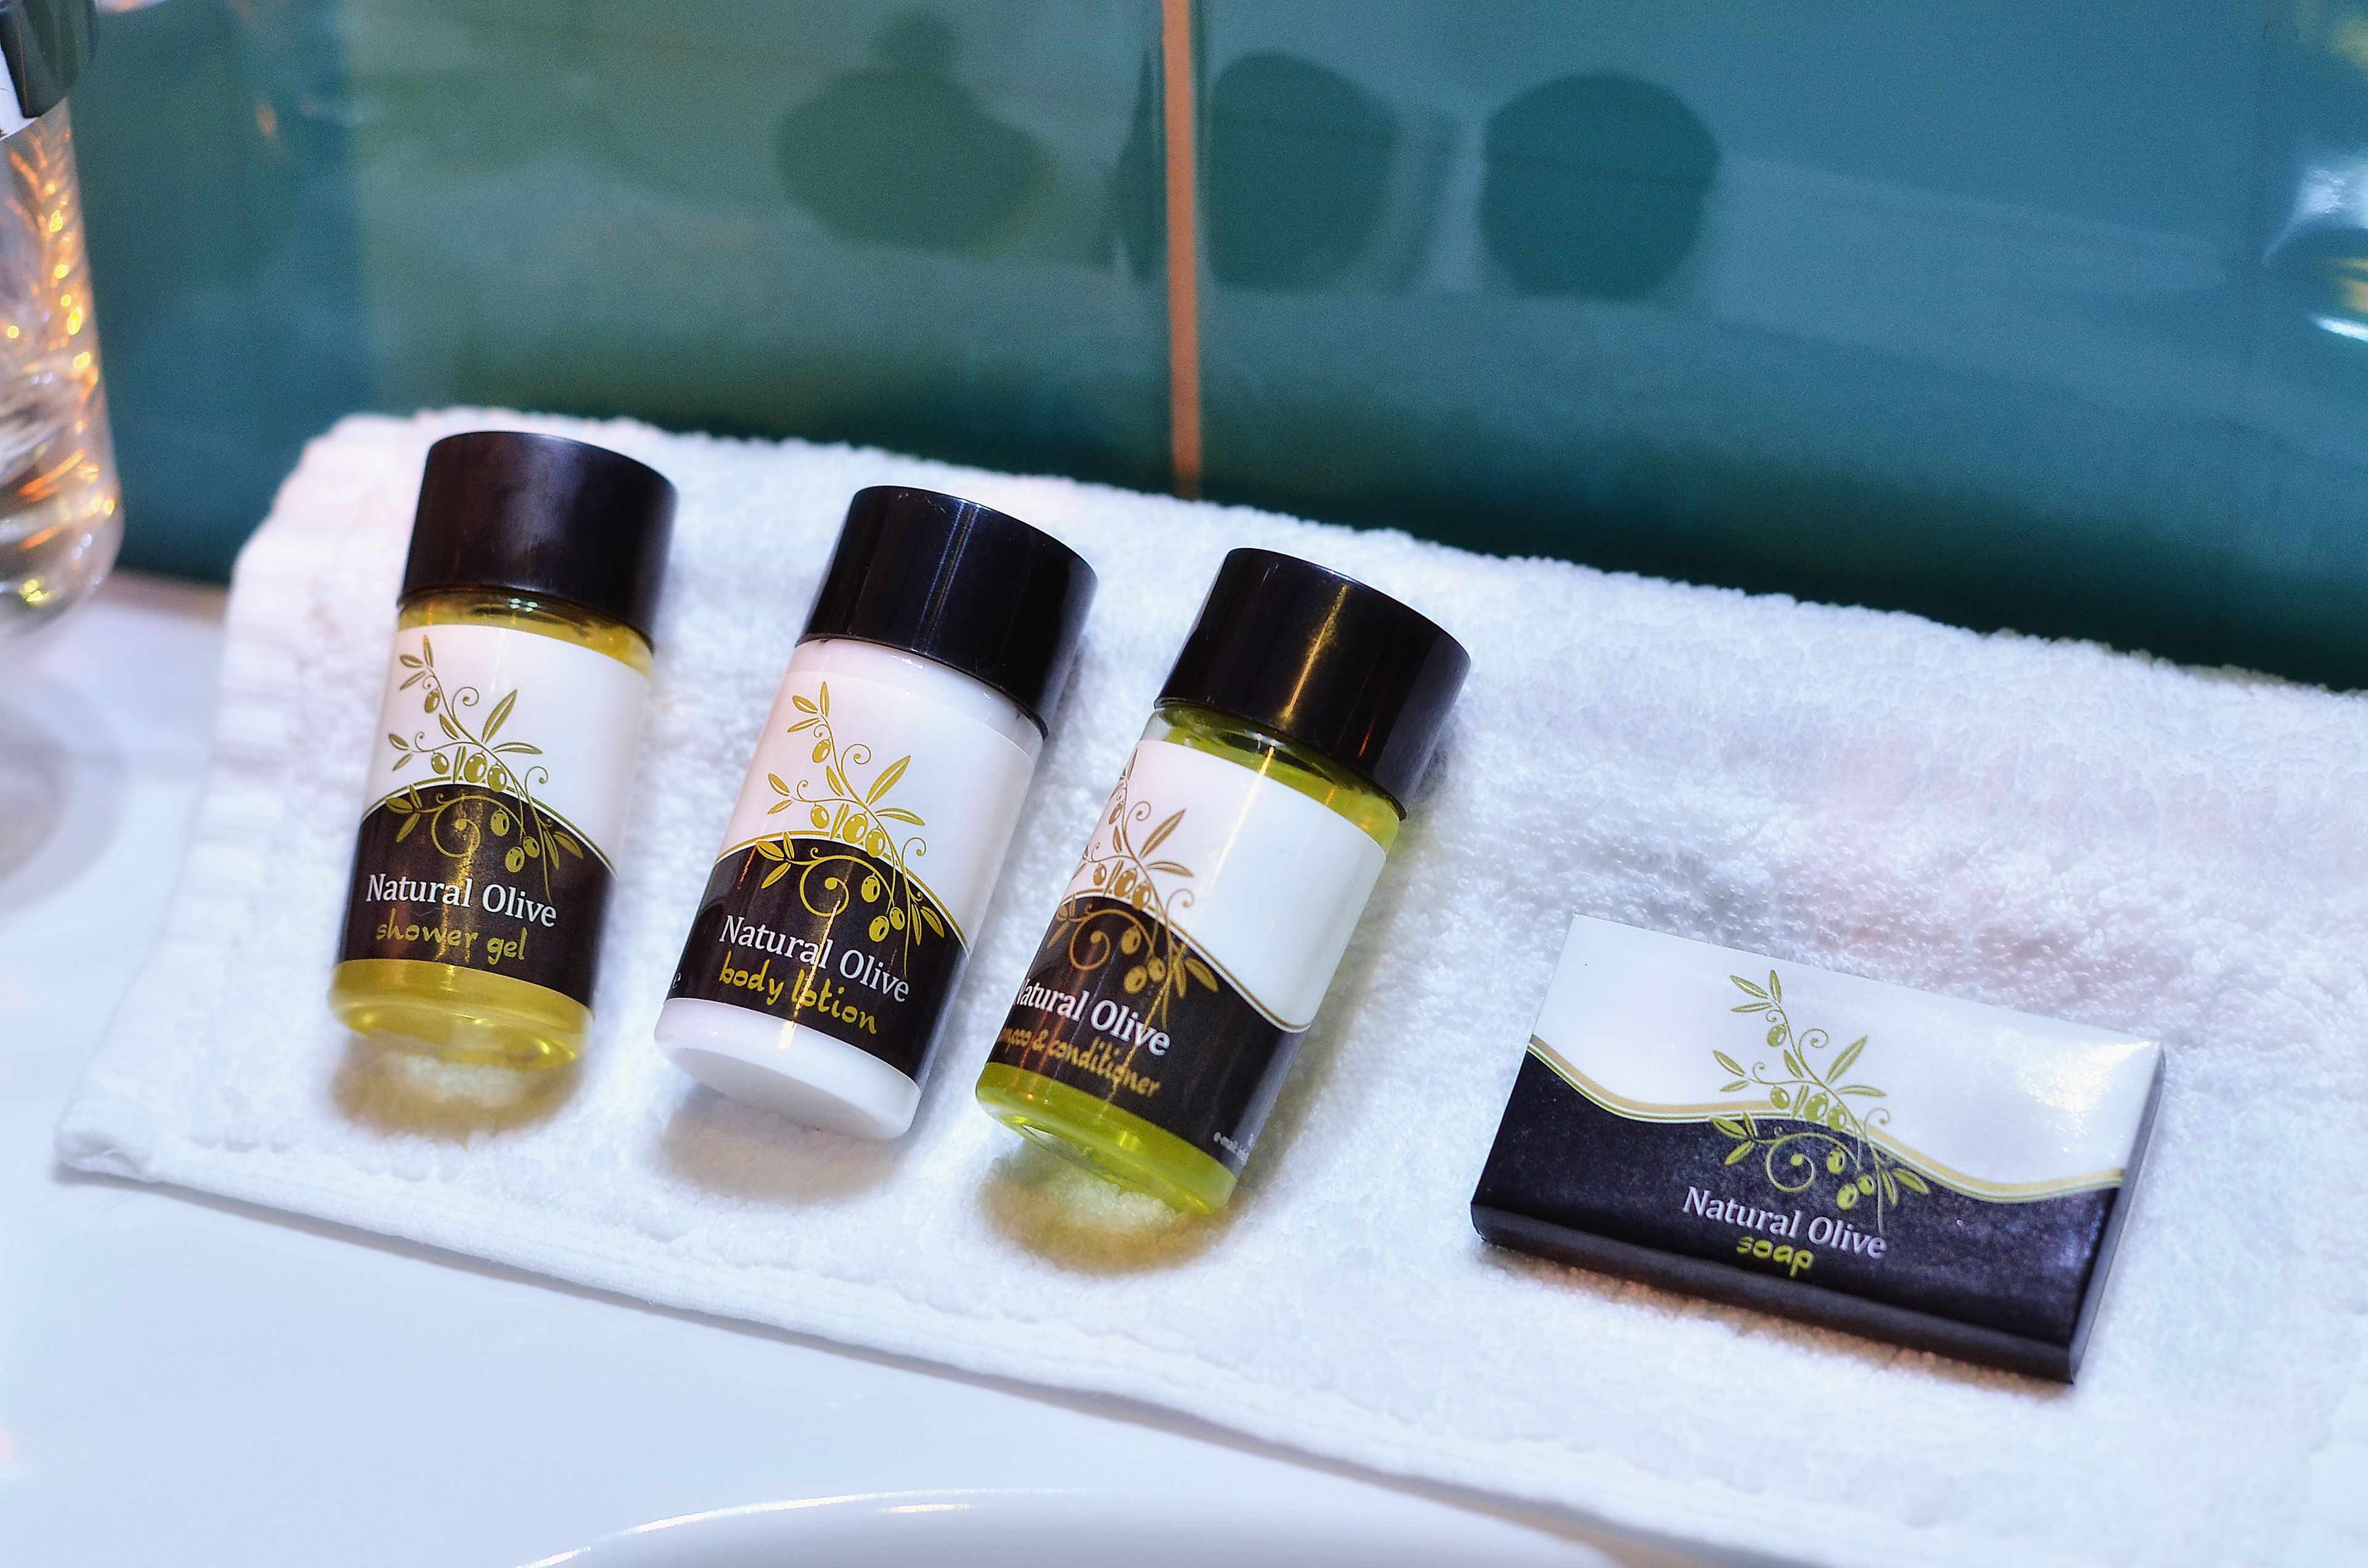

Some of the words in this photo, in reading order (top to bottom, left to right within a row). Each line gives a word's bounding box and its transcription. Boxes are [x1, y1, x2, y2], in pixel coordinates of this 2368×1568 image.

[366, 874, 472, 907] Natural
[482, 884, 557, 926] Olive
[377, 908, 478, 945] shower
[487, 927, 527, 964] gel
[719, 915, 833, 969] Natural
[840, 950, 909, 1002] Olive
[720, 951, 782, 1006] body
[791, 970, 877, 1034] lotion
[1091, 999, 1170, 1056] Olive
[1048, 1036, 1161, 1097] conditioner
[1682, 1186, 1801, 1238] Natural
[1808, 1216, 1887, 1258] Olive
[1736, 1236, 1814, 1278] soap
